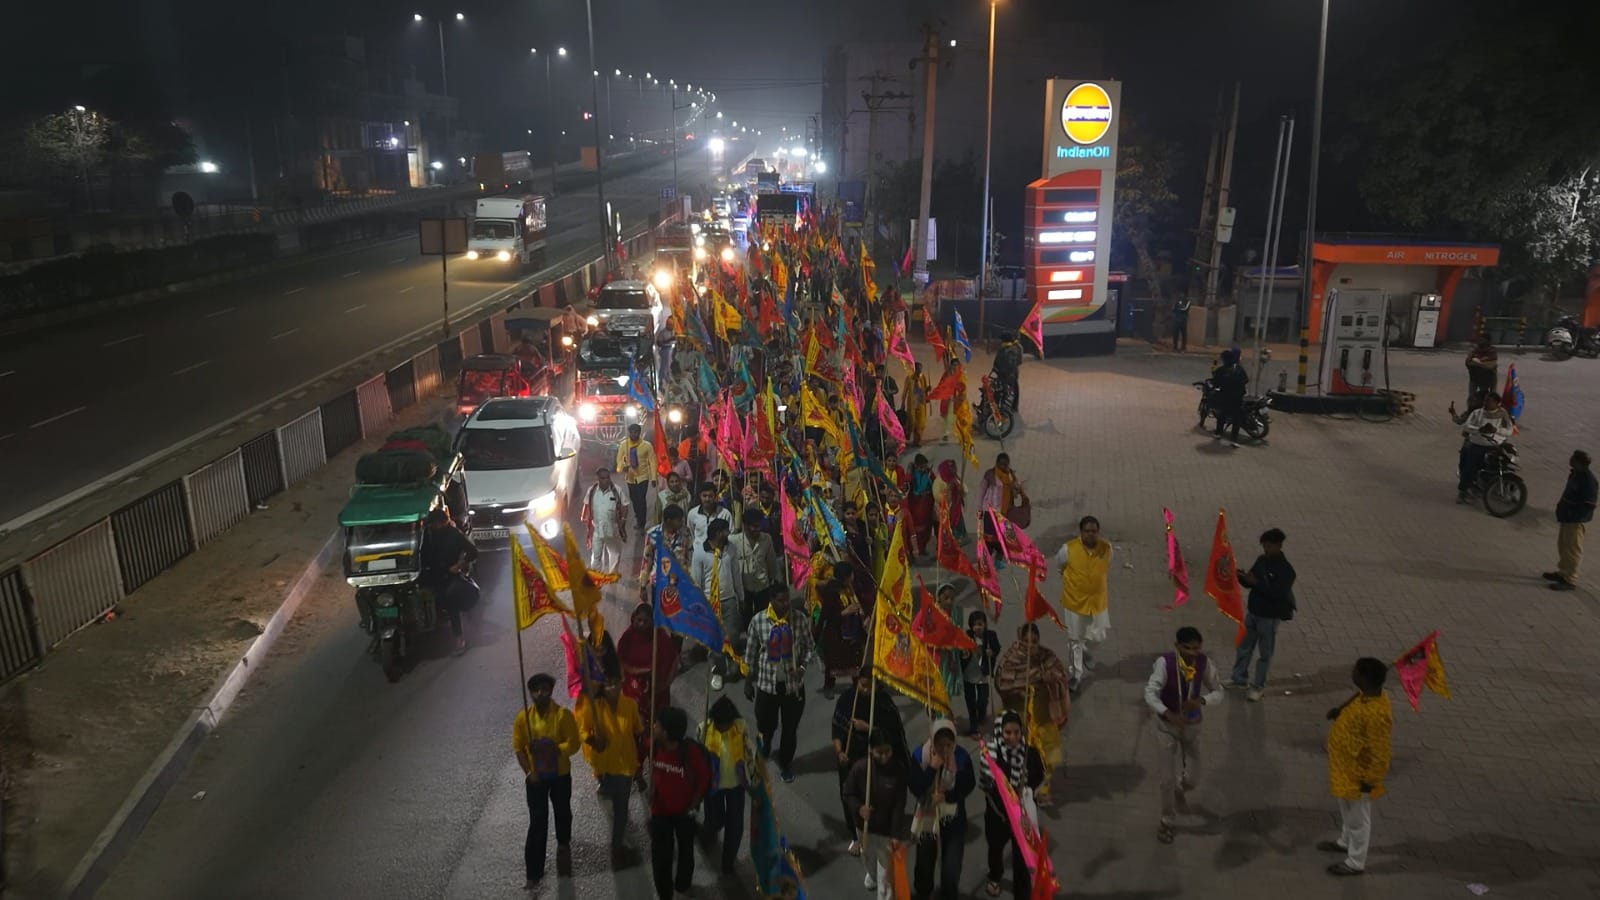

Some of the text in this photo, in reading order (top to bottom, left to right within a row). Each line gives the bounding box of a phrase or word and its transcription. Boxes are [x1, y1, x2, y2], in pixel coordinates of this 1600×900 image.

[1057, 145, 1110, 158] IndianOil
[1386, 251, 1478, 261] AIR NITROGEN
